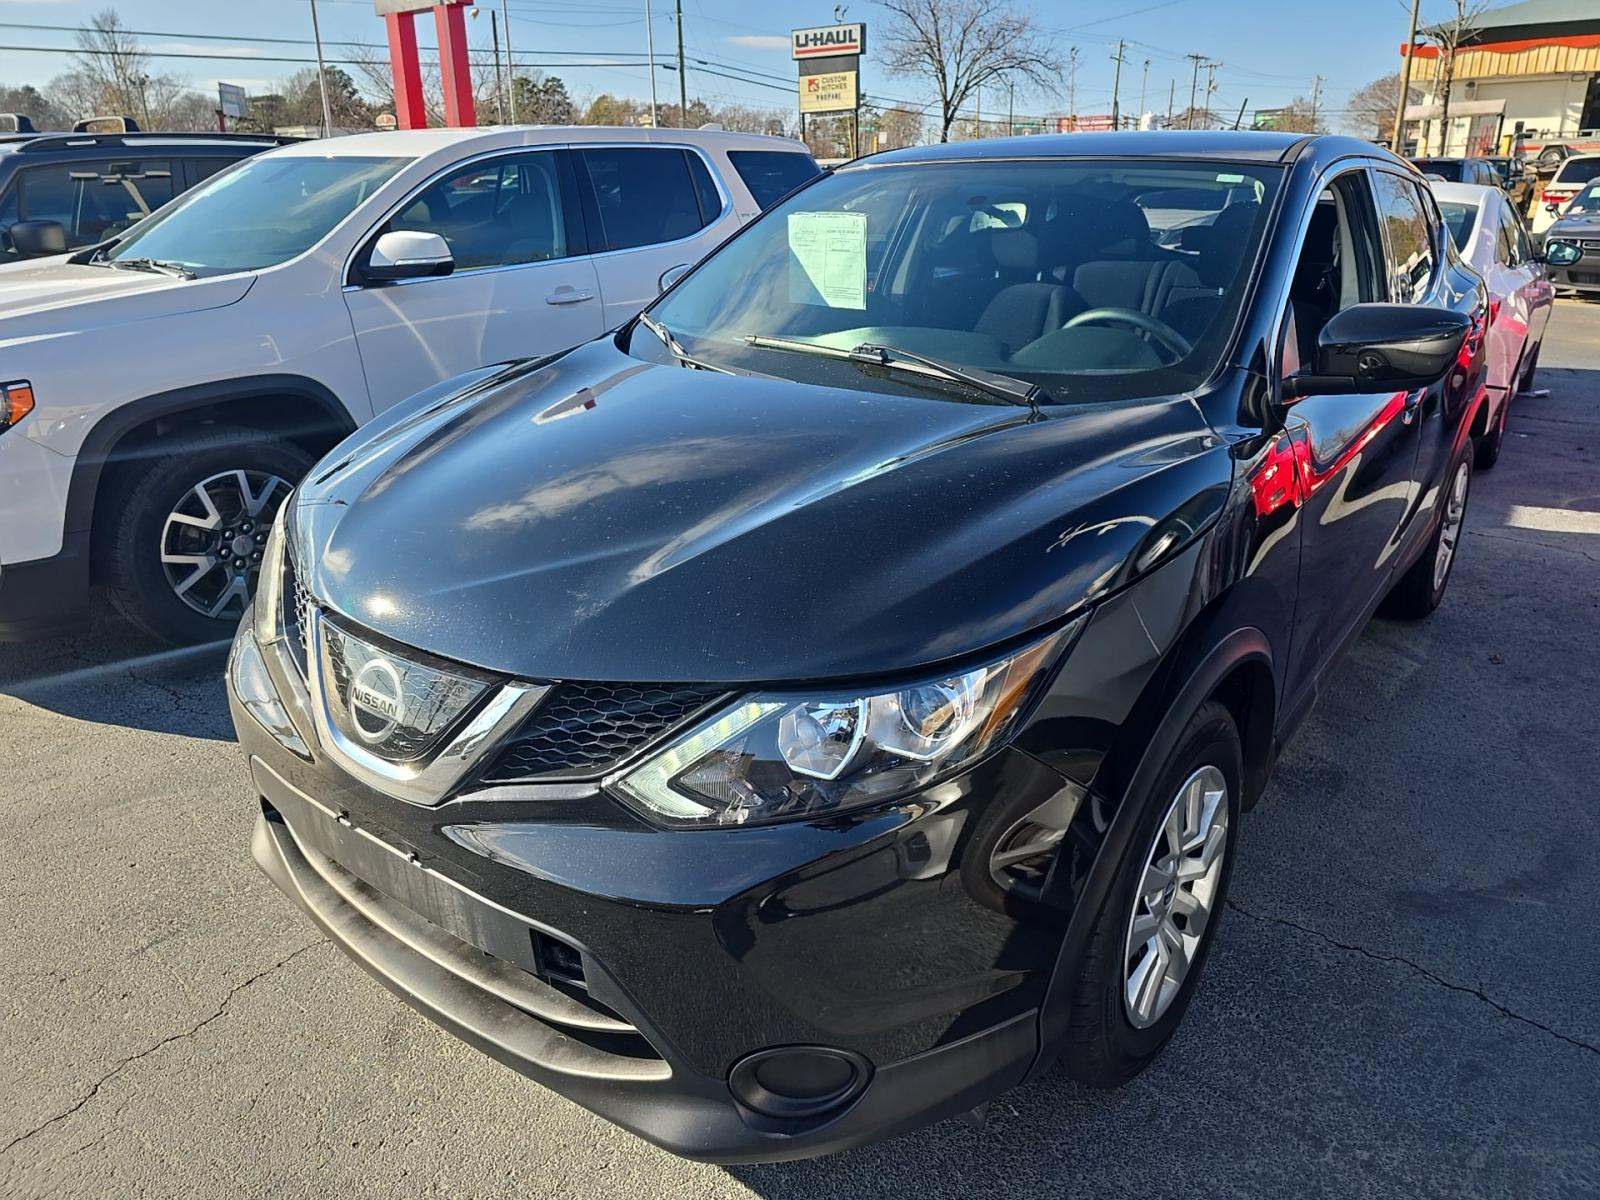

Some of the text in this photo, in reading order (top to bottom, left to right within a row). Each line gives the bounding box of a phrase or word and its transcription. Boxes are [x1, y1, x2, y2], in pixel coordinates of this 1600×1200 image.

[795, 29, 857, 47] U-HAUL
[821, 76, 847, 84] CUSTOM
[821, 83, 847, 91] HITCHES
[352, 687, 397, 716] NISSAN
